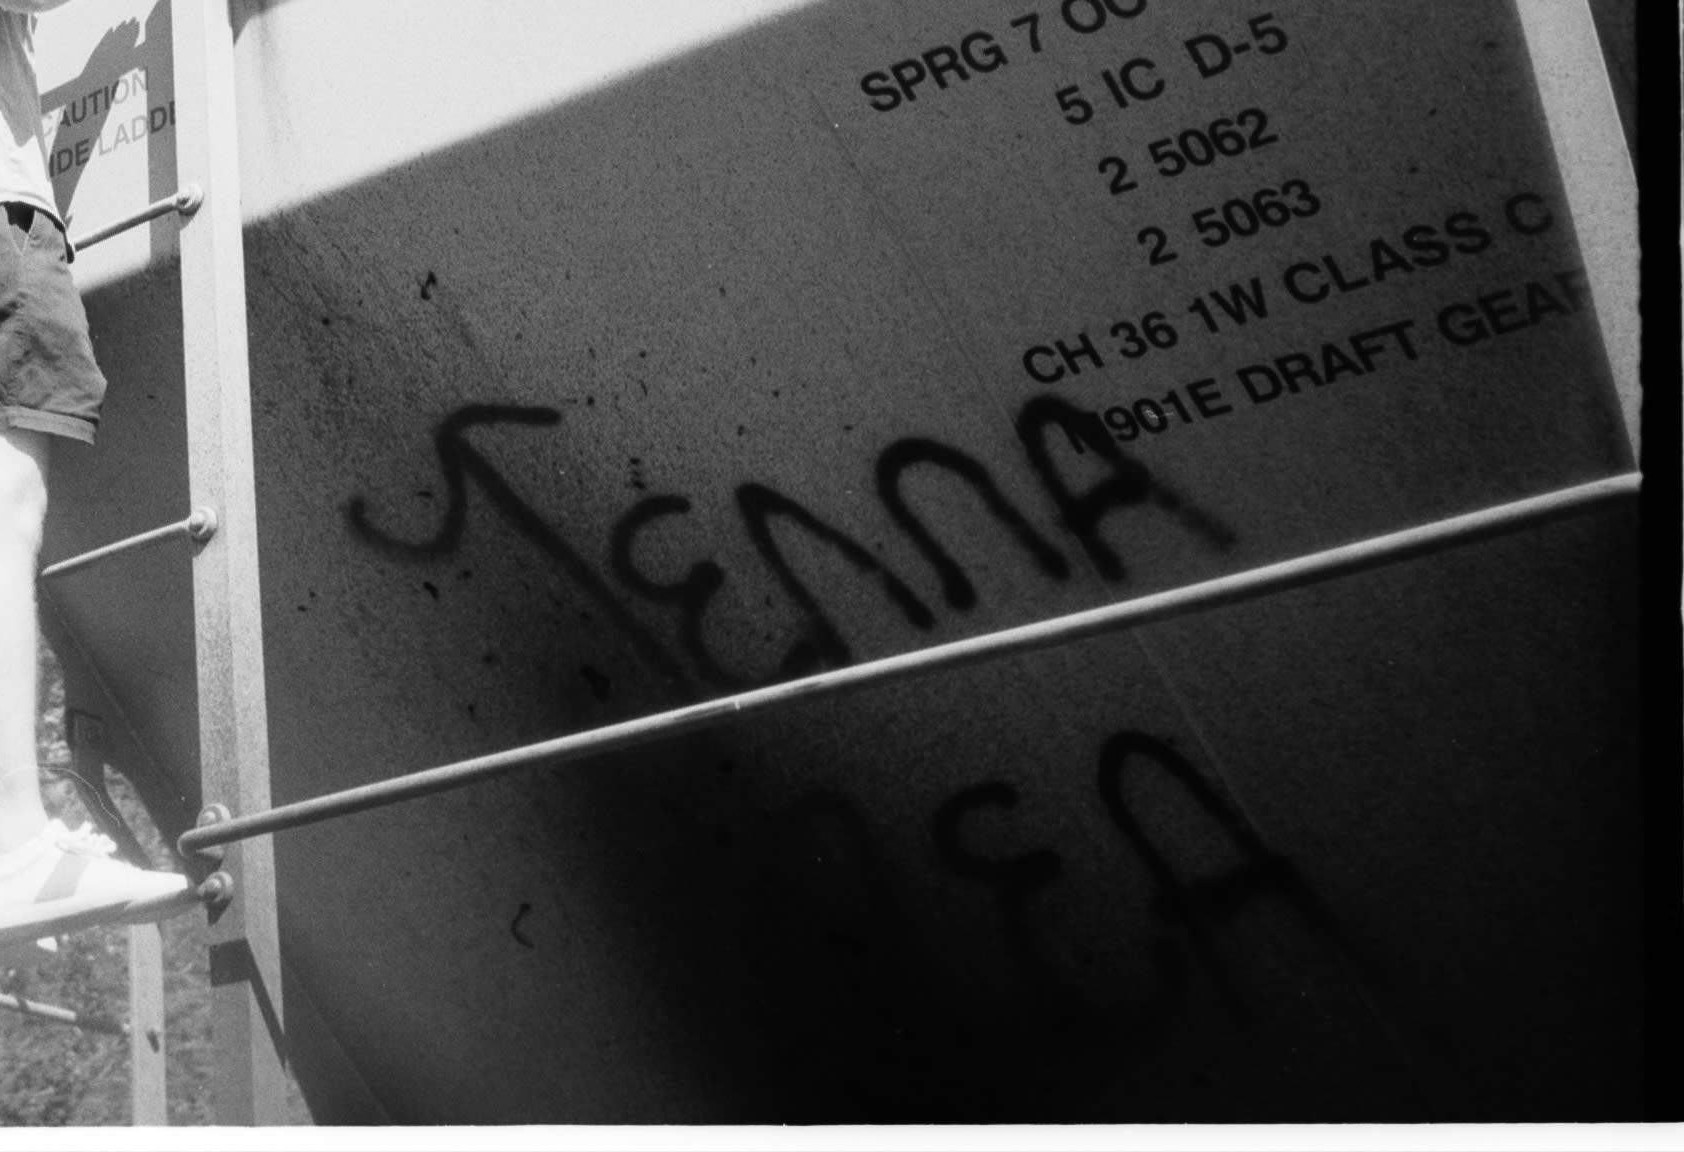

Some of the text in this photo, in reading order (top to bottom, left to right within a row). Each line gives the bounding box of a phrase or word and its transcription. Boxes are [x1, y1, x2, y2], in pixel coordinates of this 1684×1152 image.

[860, 29, 1009, 113] SPRG
[1009, 11, 1043, 54] 7
[1054, 11, 1289, 126] 5 IC D-5
[48, 100, 176, 179] IDE LADD
[1097, 107, 1279, 196] 2 5062
[1136, 178, 1321, 266] 2 5063
[1022, 192, 1555, 384] CH 36 1W CLASS C
[1234, 319, 1419, 404] DRAFT
